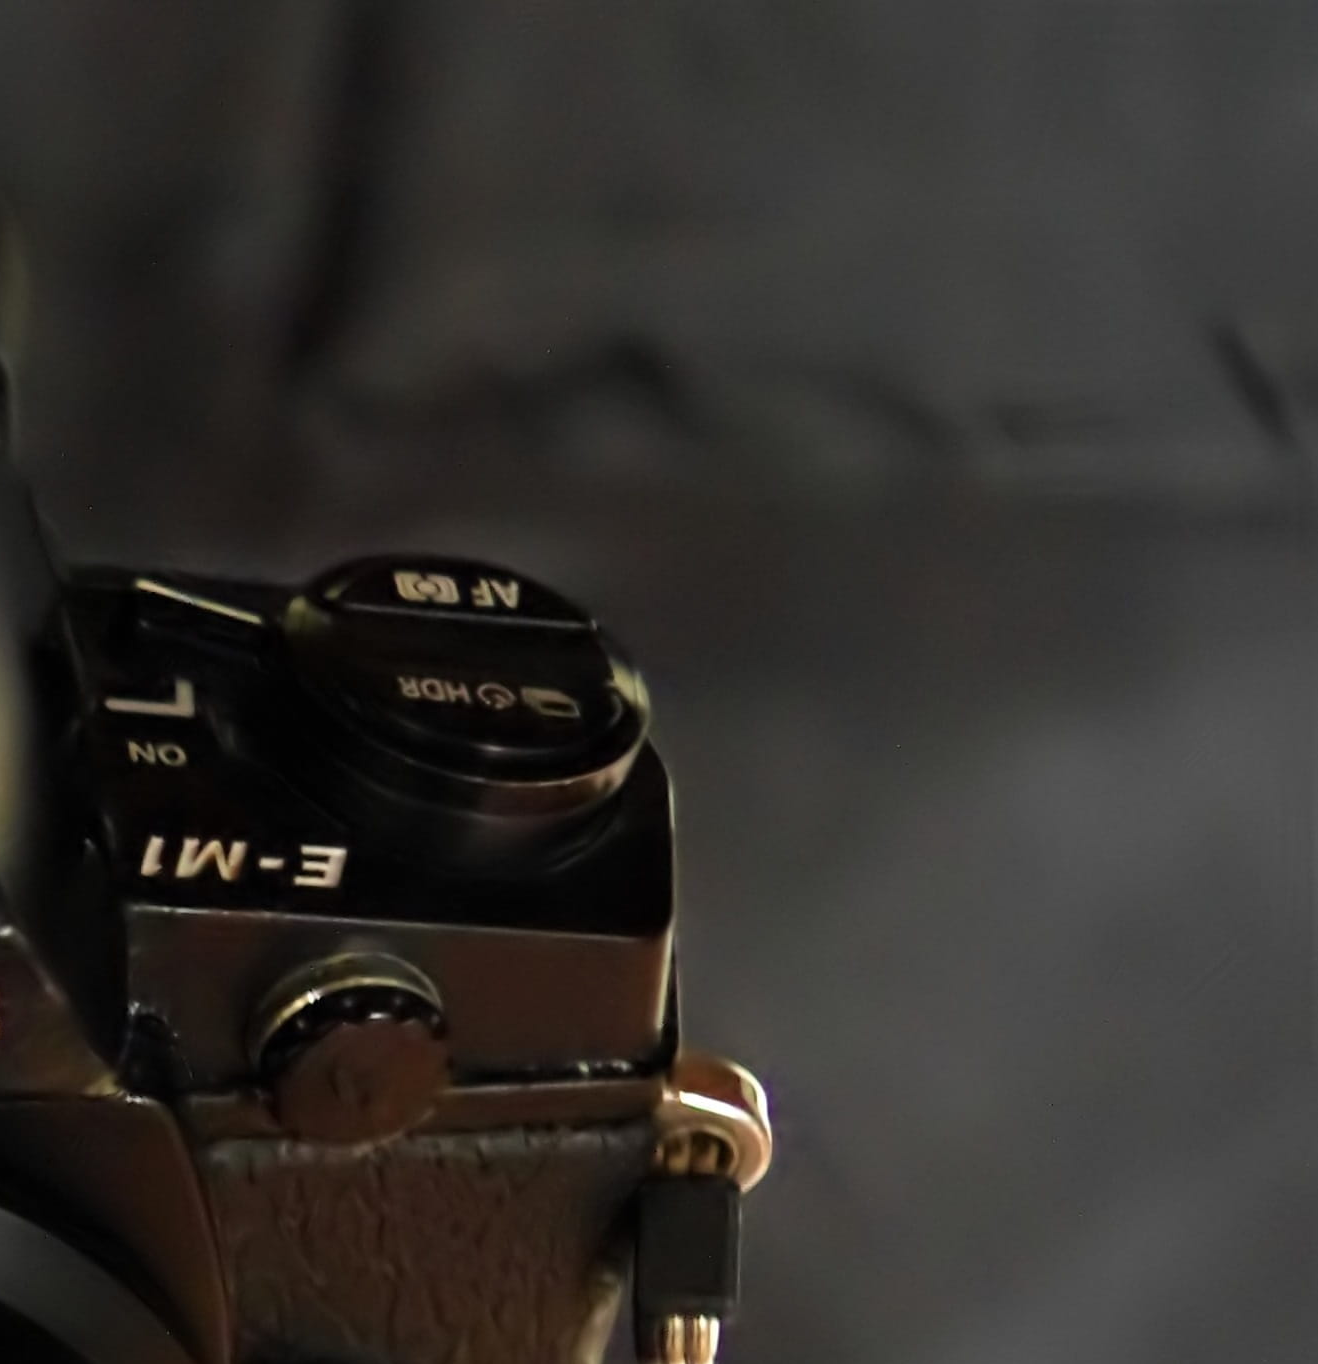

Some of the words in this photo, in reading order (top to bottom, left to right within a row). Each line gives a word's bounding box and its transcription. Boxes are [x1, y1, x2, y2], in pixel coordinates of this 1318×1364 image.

[470, 577, 520, 610] AF
[396, 675, 472, 705] HDR
[126, 739, 188, 768] ON
[139, 834, 349, 889] E-M1
